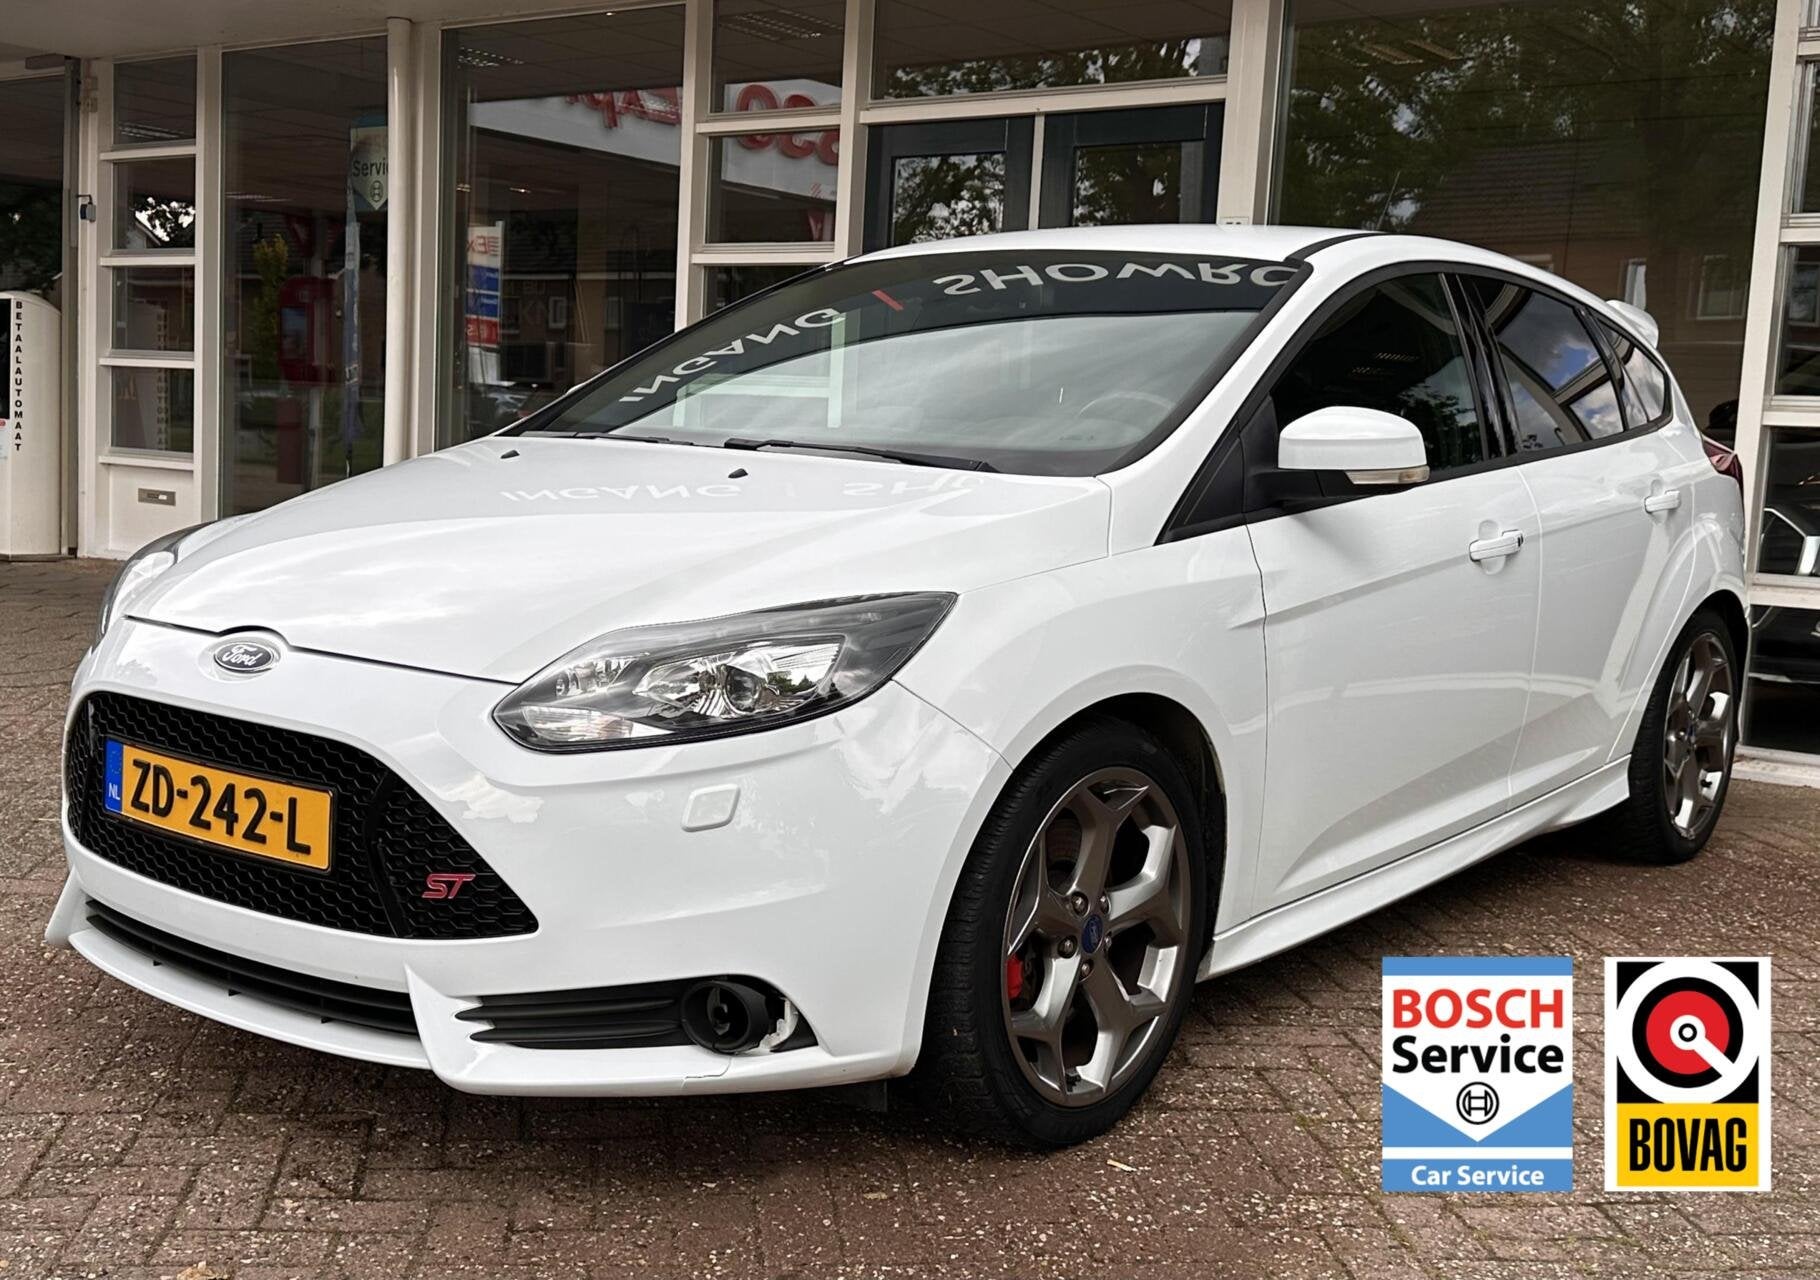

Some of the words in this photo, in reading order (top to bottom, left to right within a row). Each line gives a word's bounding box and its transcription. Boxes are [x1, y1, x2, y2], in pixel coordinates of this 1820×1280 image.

[352, 157, 388, 177] Servi
[14, 301, 23, 451] BETAALAUTOMAAT
[222, 645, 263, 666] Ford
[108, 783, 120, 800] NL
[131, 759, 311, 855] ZD-242-L
[422, 873, 475, 899] ST
